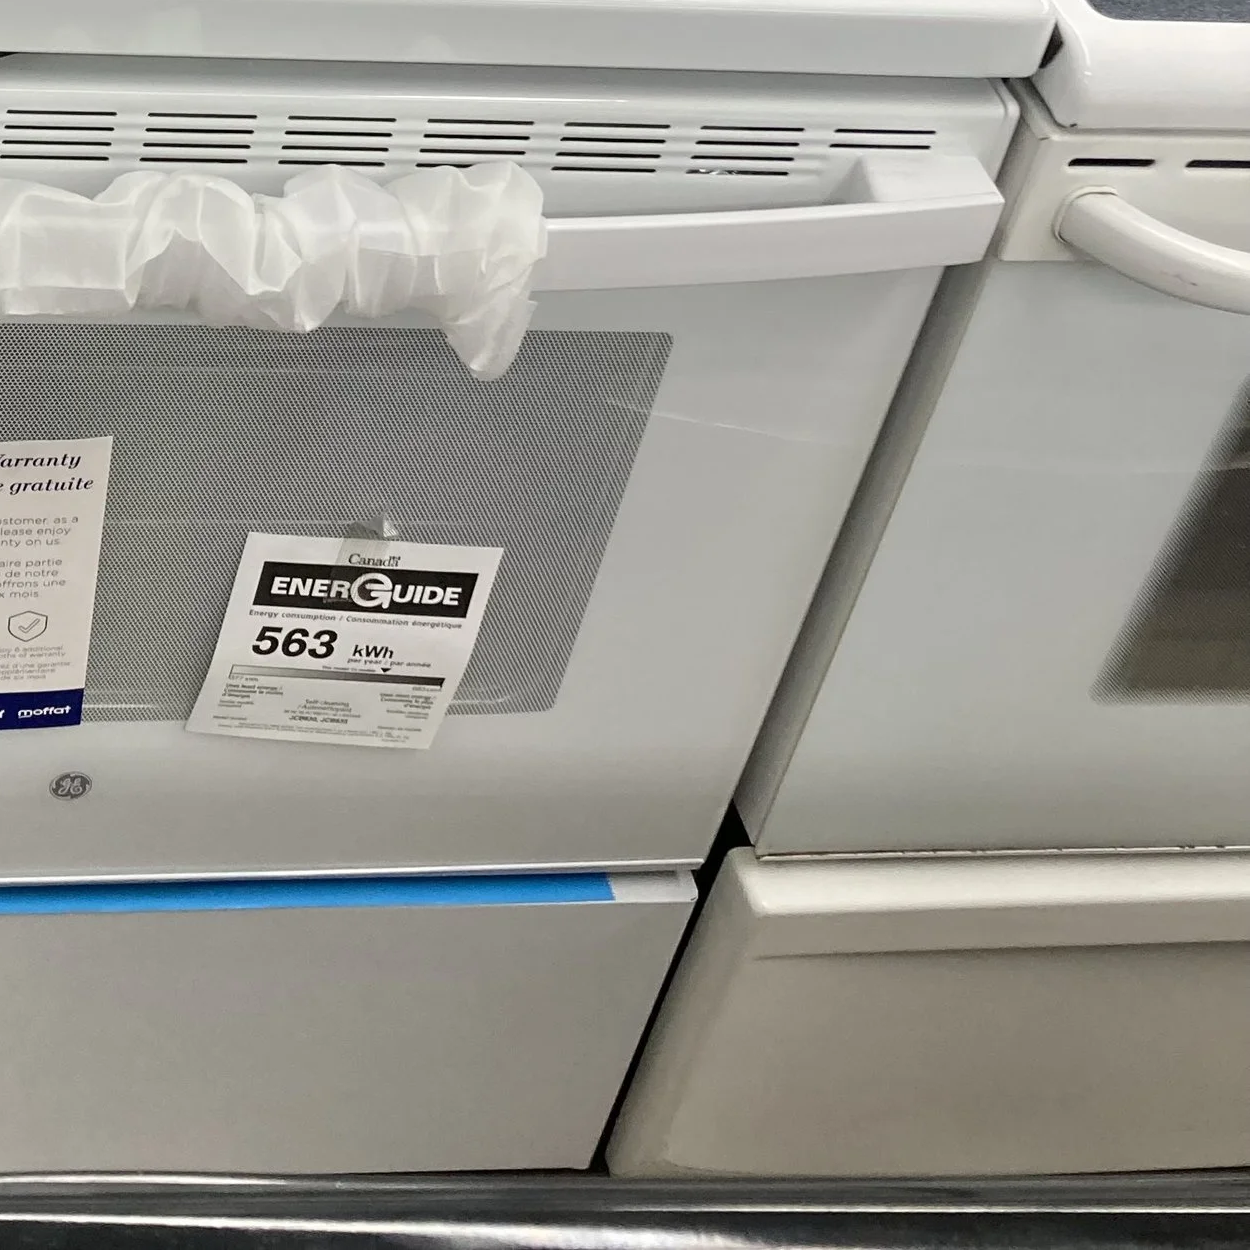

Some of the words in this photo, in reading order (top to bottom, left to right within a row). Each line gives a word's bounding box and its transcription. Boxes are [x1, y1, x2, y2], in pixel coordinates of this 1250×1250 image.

[10, 477, 94, 495] gratuite
[72, 516, 79, 524] a
[37, 527, 71, 536] enjoy
[25, 538, 42, 546] on
[25, 558, 63, 568] partie
[348, 553, 401, 568] Canada
[5, 569, 21, 578] de
[25, 569, 59, 577] notre
[43, 579, 66, 587] une
[270, 572, 462, 609] ENERGUIDE
[249, 609, 279, 618] Energy
[281, 612, 336, 621] consumption
[346, 616, 409, 626] Consommation
[412, 620, 462, 630] énergétique
[252, 626, 338, 659] 563
[352, 644, 394, 659] kWh
[18, 705, 71, 719] moffat
